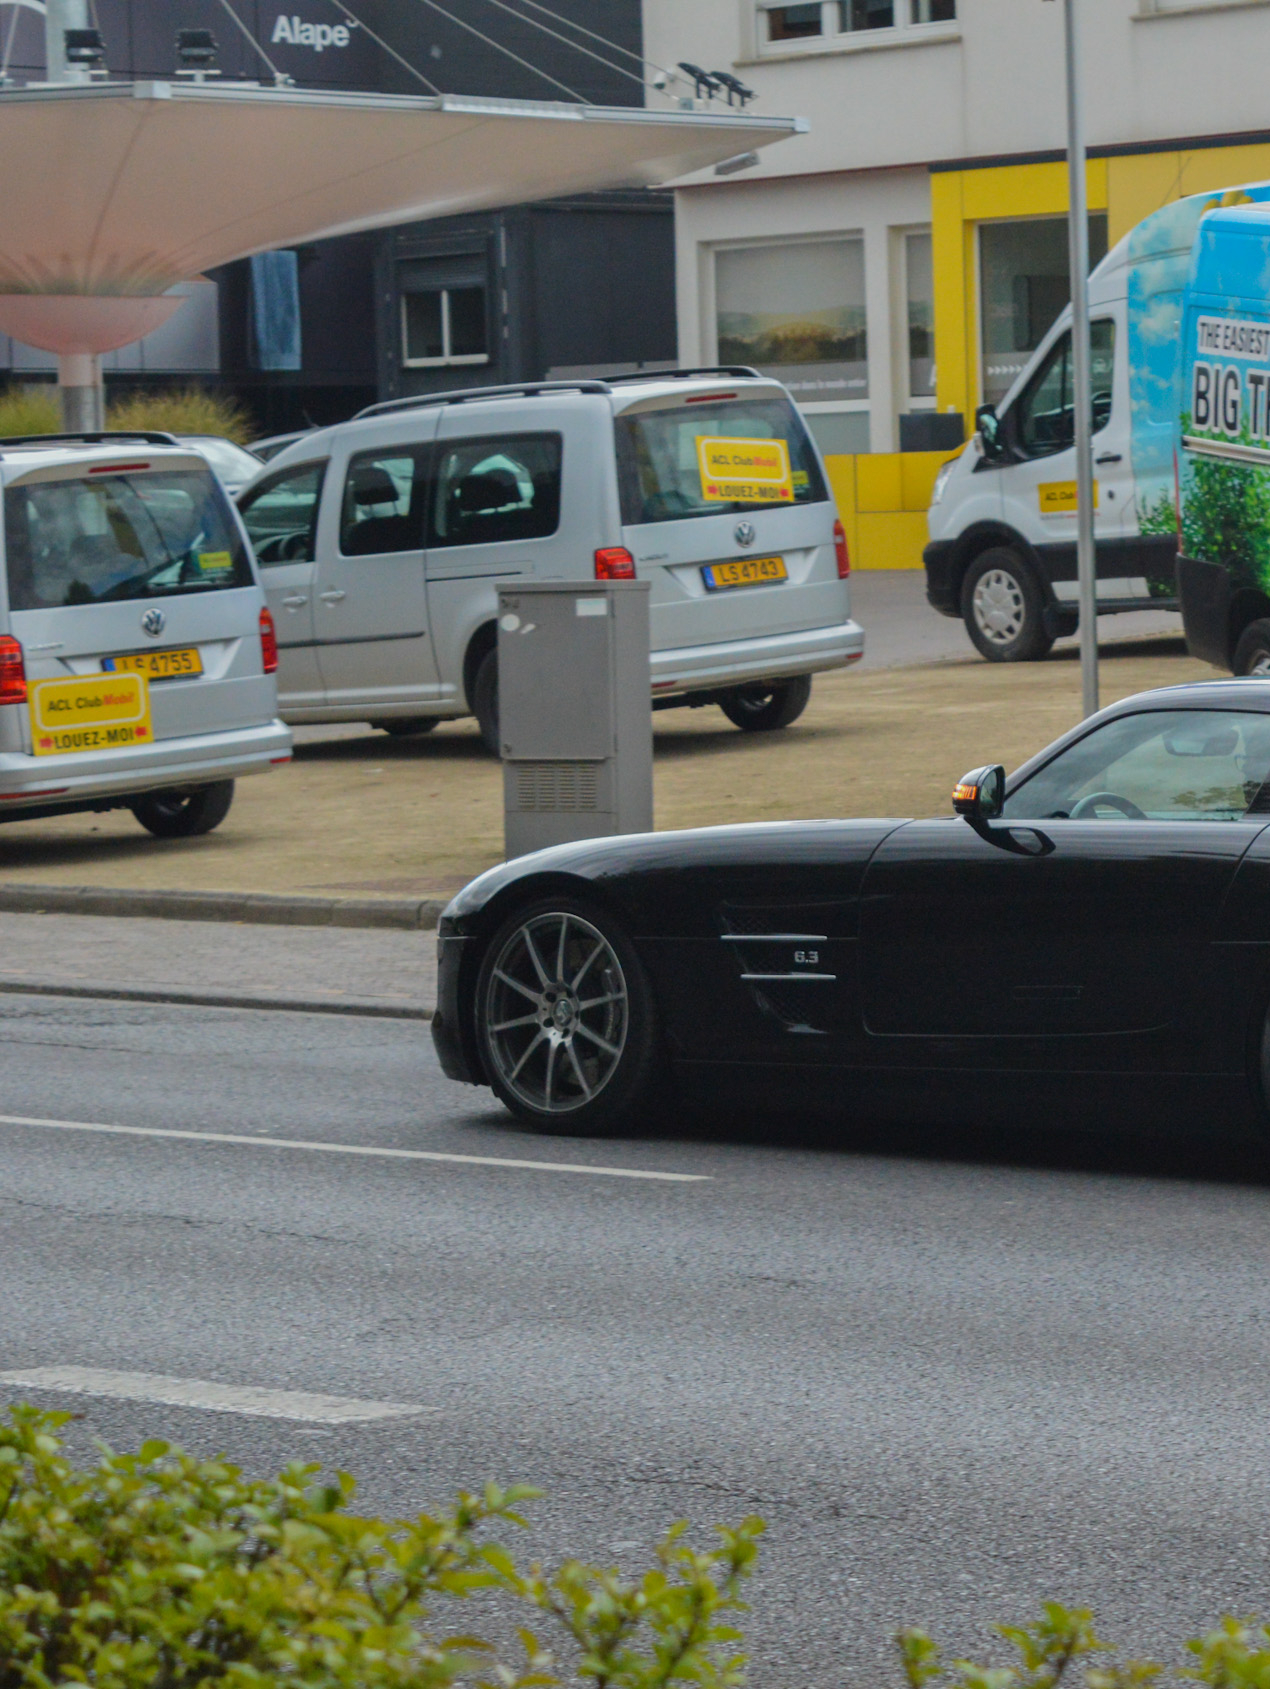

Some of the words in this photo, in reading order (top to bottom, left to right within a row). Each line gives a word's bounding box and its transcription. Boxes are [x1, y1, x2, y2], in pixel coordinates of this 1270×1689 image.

[272, 14, 350, 52] Alape
[1200, 322, 1221, 349] THE
[1223, 325, 1270, 354] EASIEST
[1194, 365, 1239, 431] BIG
[718, 565, 739, 583] LS
[742, 561, 779, 578] 4743
[150, 653, 193, 673] 4755
[47, 699, 72, 712] ACL
[54, 727, 134, 749] LOUEZ-MOI
[794, 951, 819, 963] 6.3
